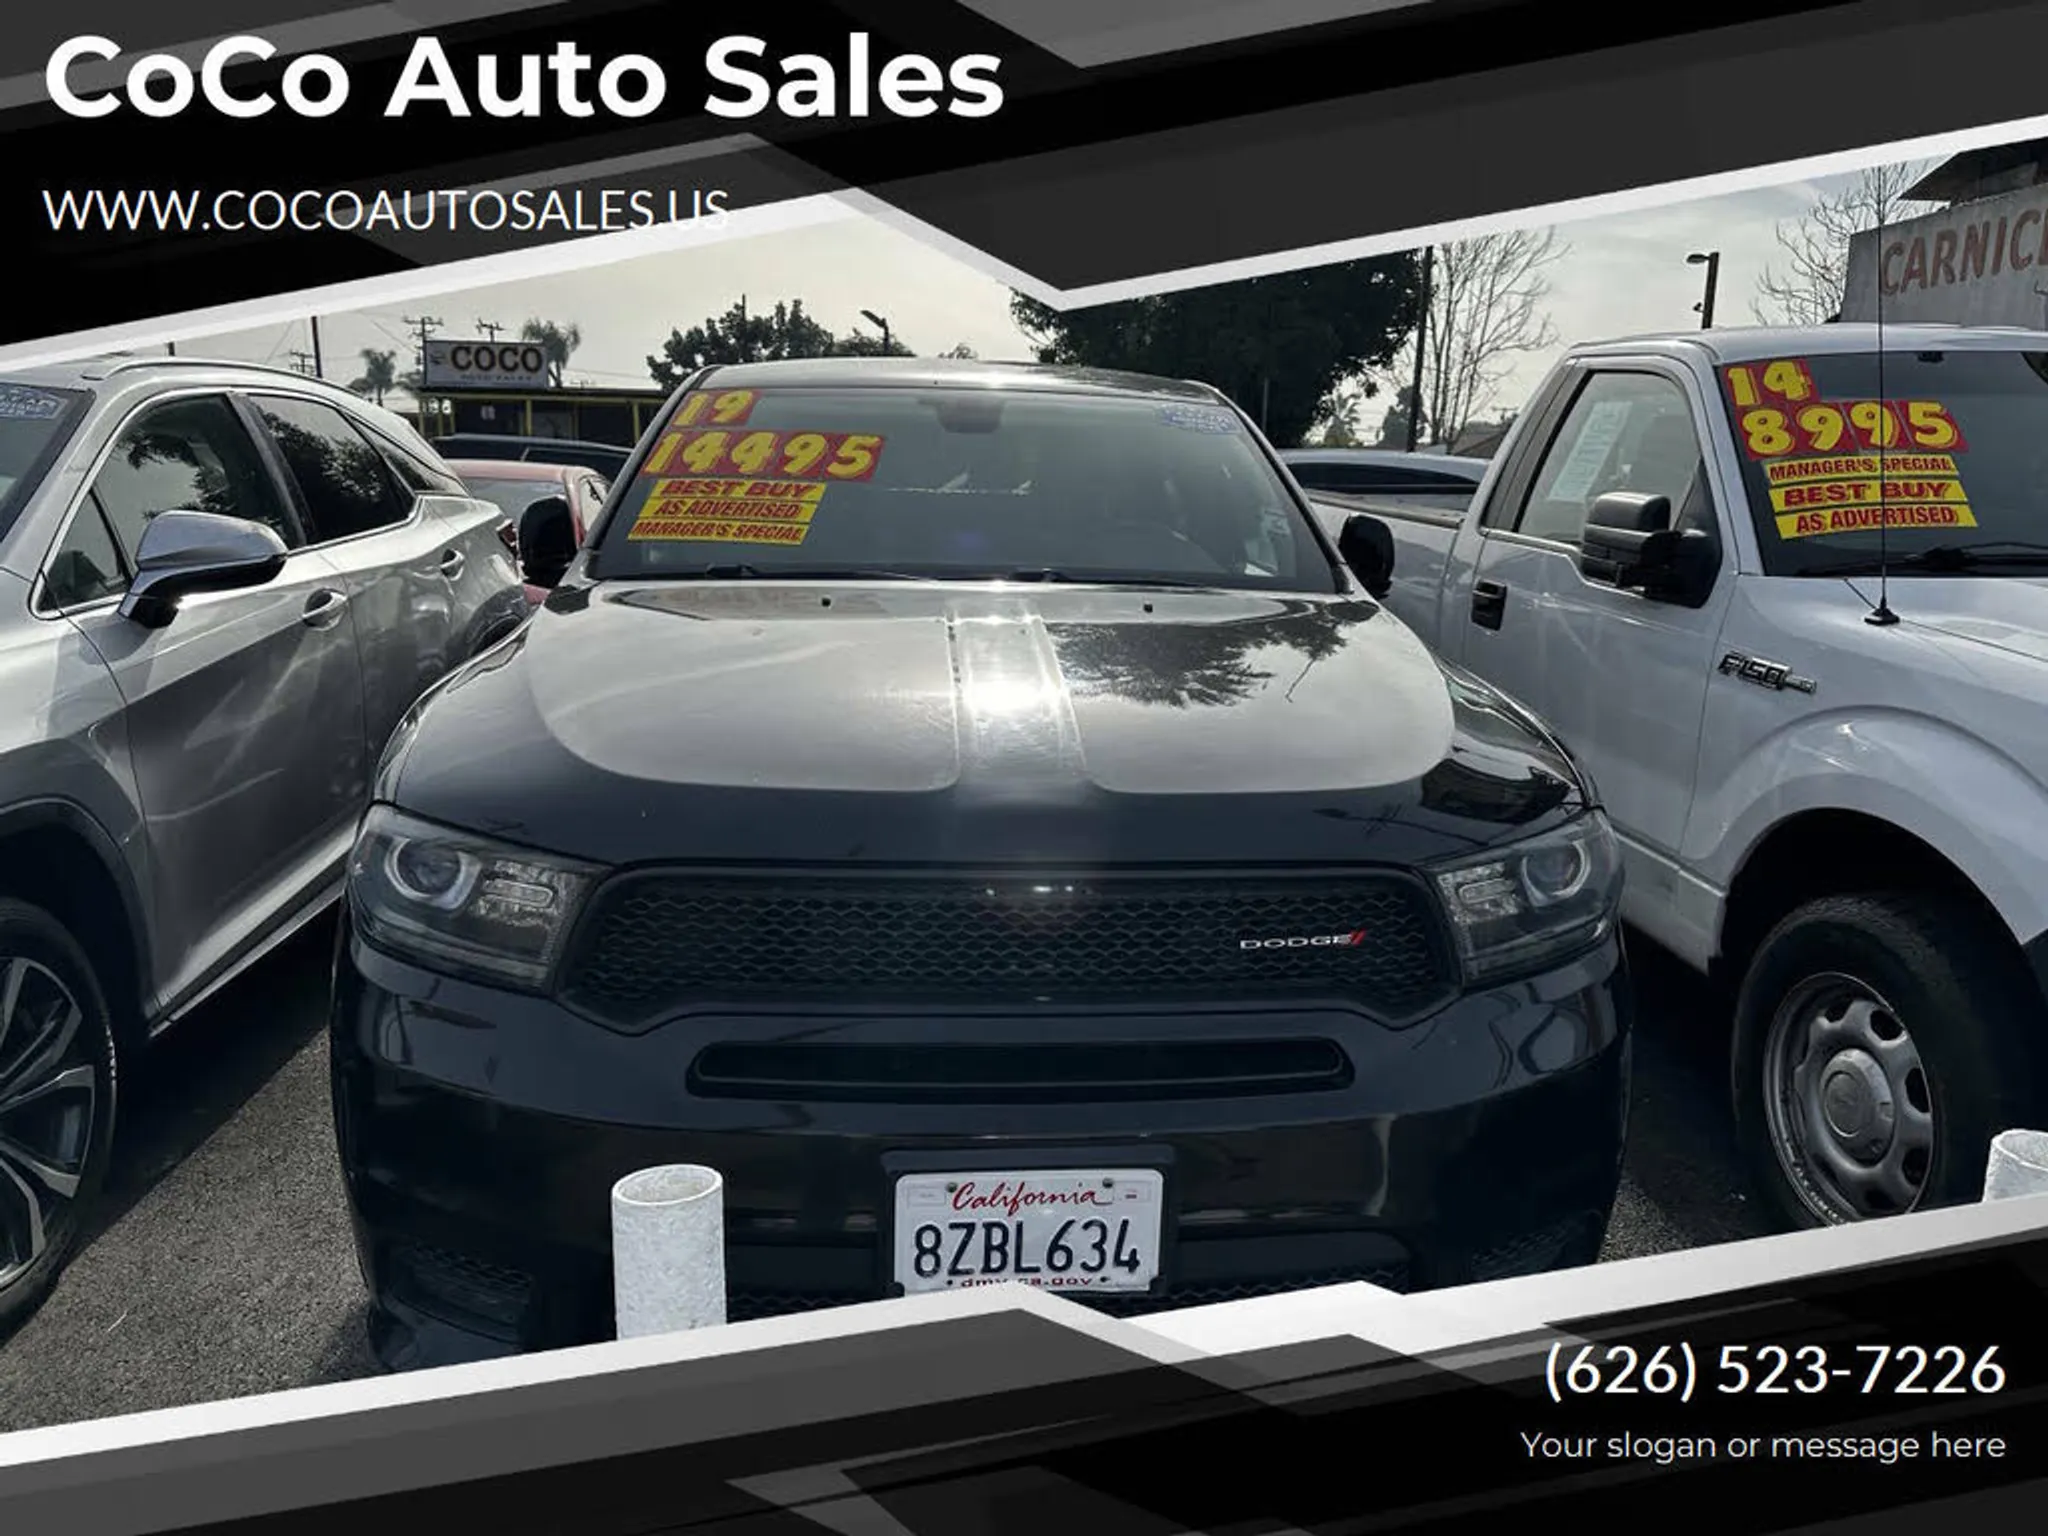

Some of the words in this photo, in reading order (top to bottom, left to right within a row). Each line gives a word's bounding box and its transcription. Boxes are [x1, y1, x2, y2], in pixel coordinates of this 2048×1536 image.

[451, 345, 543, 373] COCO
[1727, 361, 1810, 406] 14
[672, 390, 754, 426] 19
[1741, 400, 1957, 455] 8995
[643, 432, 882, 478] 14495
[1769, 458, 1874, 481] MANAGER'S
[1880, 456, 1951, 472] SPECIAL
[659, 479, 744, 496] BEST
[745, 481, 817, 498] BUY
[1784, 484, 1870, 507] BEST
[1880, 482, 1948, 499] BUY
[654, 500, 683, 515] AS
[684, 502, 801, 518] ADVERTISED
[1796, 514, 1827, 534] AS
[1830, 507, 1959, 529] ADVERTISED
[630, 521, 730, 538] MANAGER'S
[732, 524, 806, 540] SPECIAL
[1240, 934, 1351, 949] DODGE
[951, 1182, 1113, 1216] California
[913, 1219, 1140, 1278] 8ZBL634
